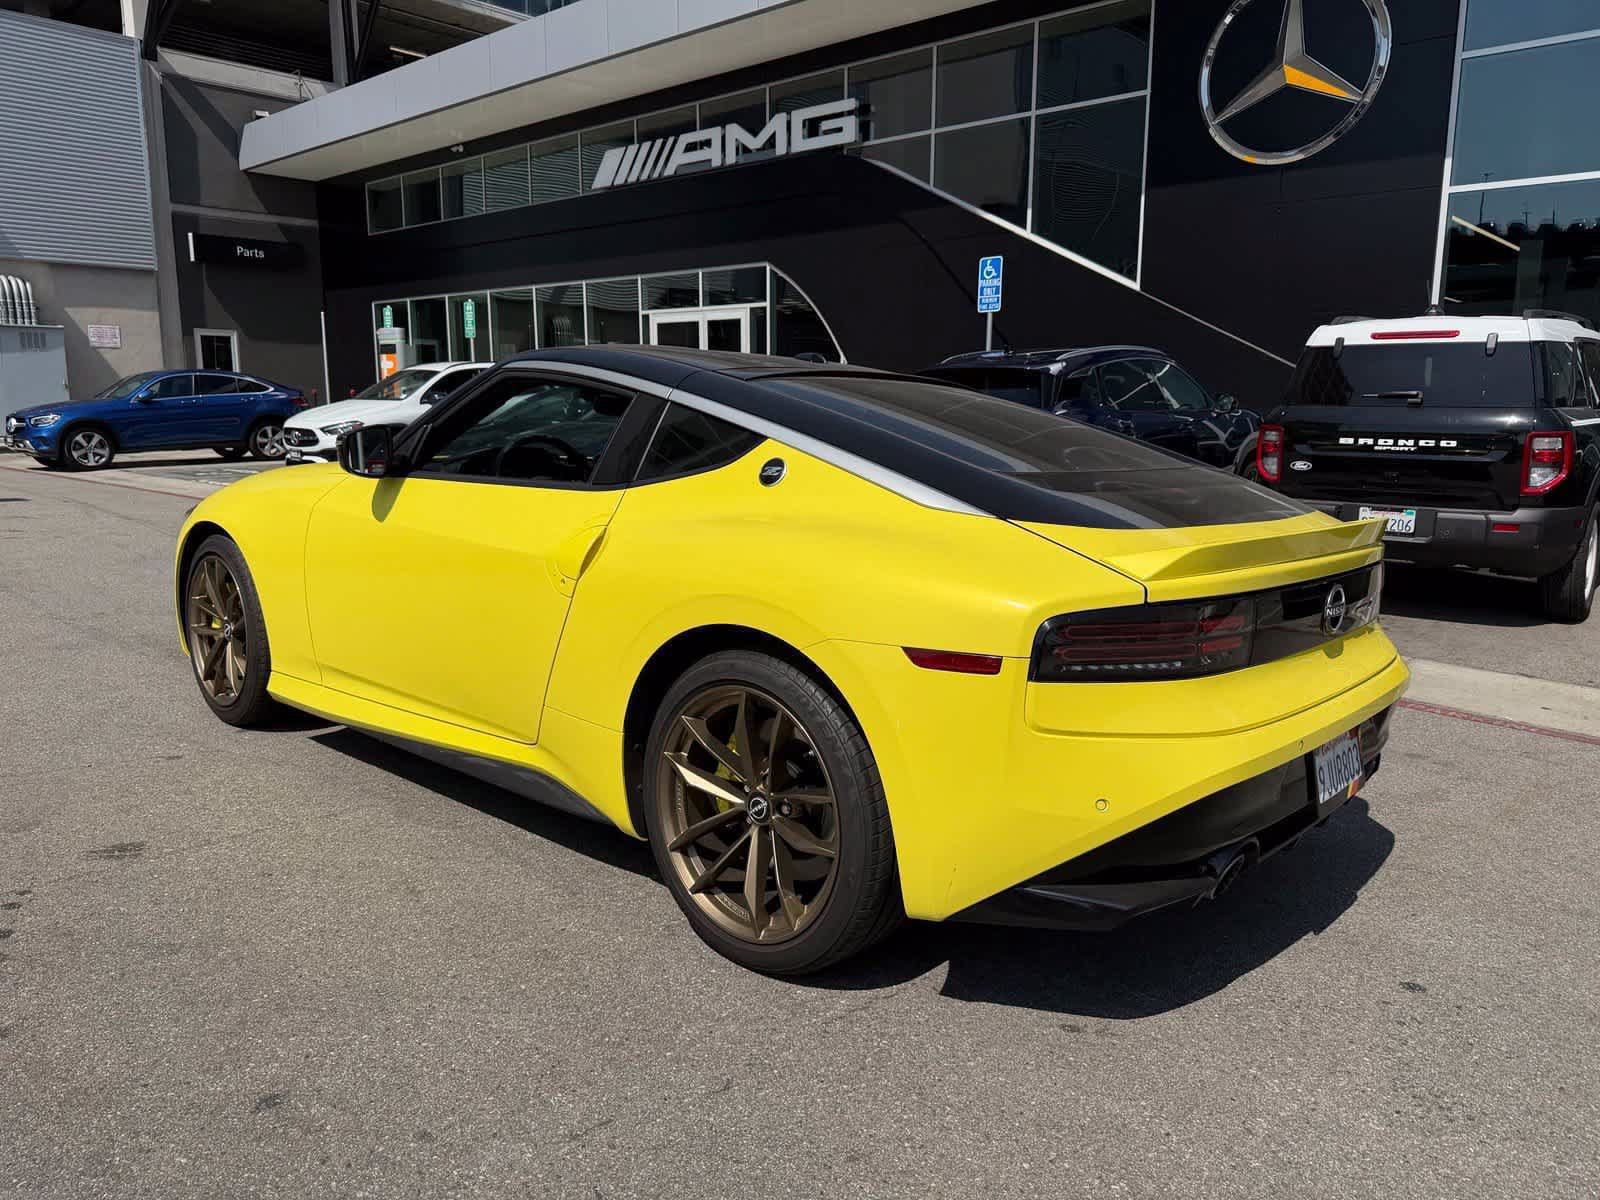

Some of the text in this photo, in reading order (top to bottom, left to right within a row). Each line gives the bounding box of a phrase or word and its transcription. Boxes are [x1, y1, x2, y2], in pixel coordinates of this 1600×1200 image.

[663, 97, 857, 177] AMG
[236, 245, 265, 258] Parts
[1339, 437, 1457, 447] BRONCO
[1318, 743, 1361, 801] 9JUR803
